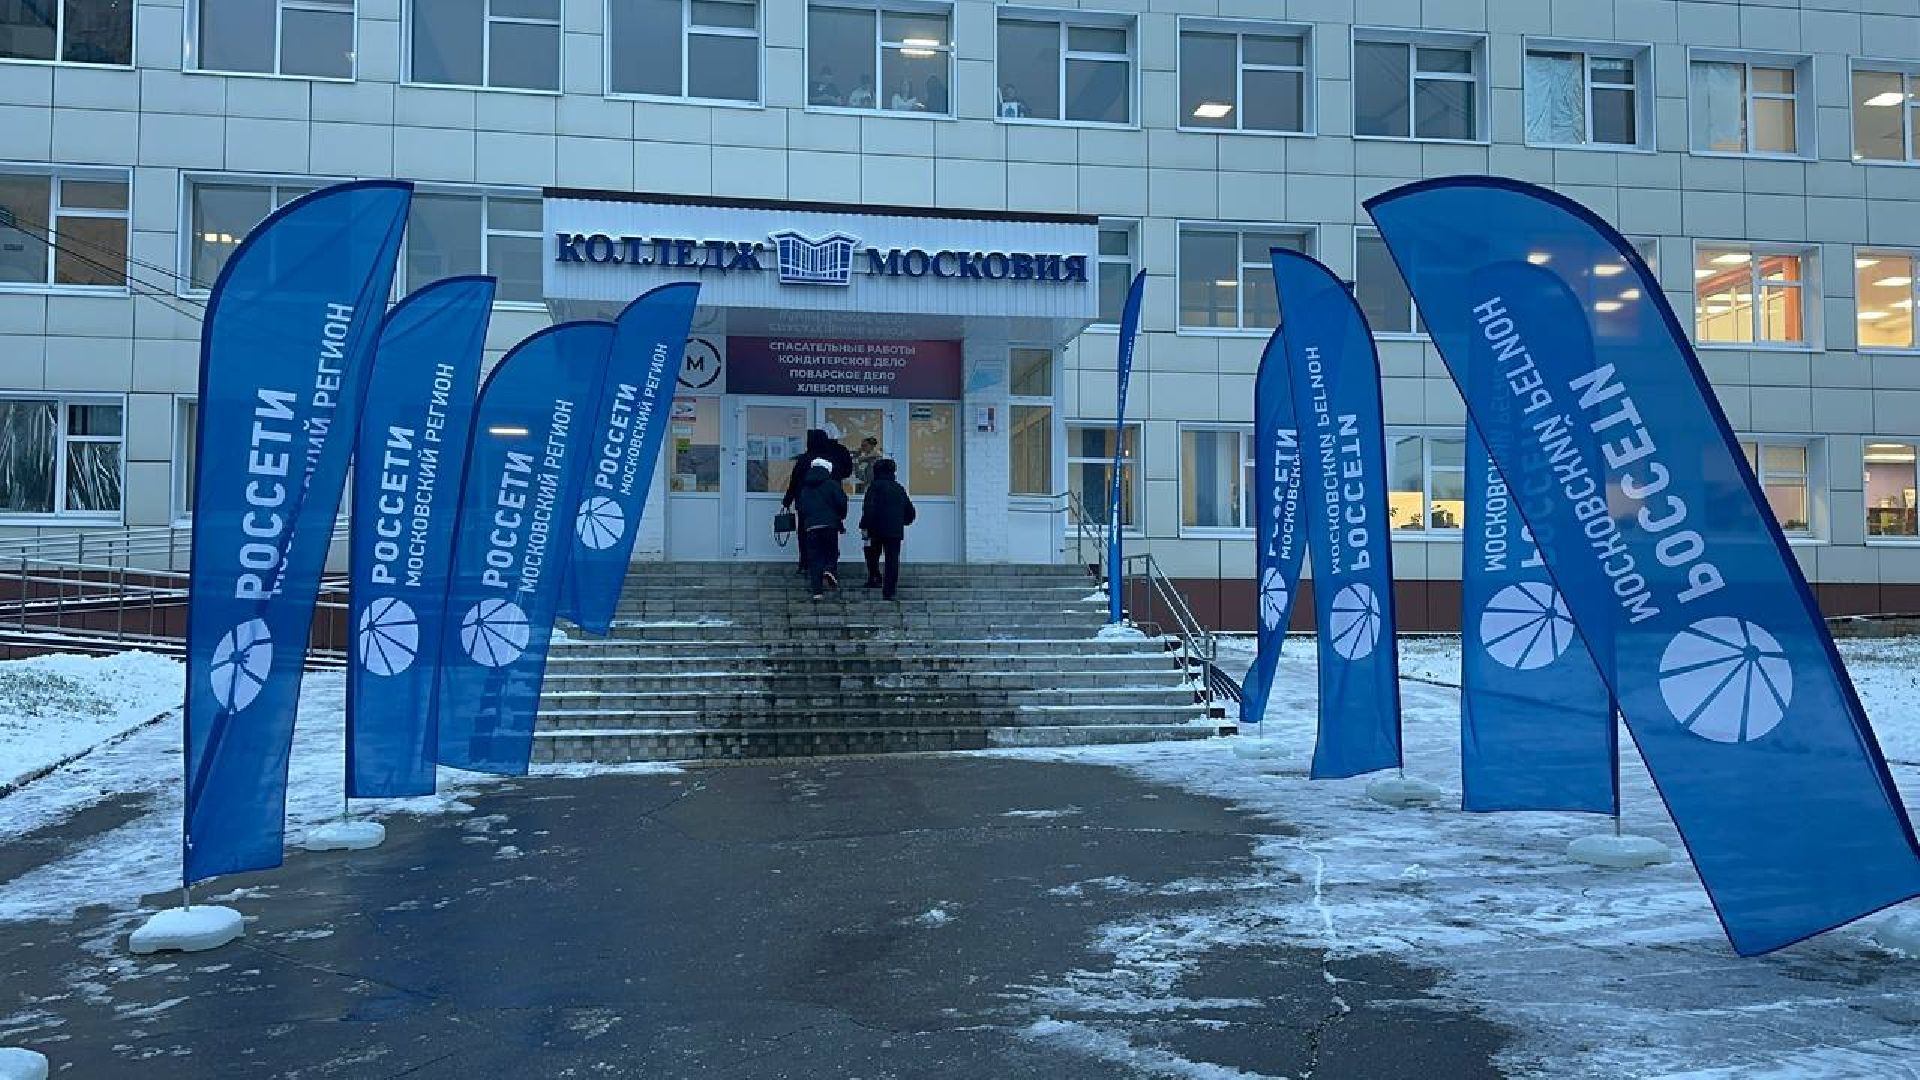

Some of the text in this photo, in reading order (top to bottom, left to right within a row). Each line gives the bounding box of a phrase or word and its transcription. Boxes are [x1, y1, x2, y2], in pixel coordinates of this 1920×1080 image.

[555, 233, 1088, 282] КОЛЛЕДЖ МОСКОВИЯ
[313, 302, 354, 409] РЕГИОН
[769, 341, 916, 355] СПАСАТЕЛЬНЫЕ РАБОТЫ
[779, 354, 907, 368] КОНДИТЕРСКОЕ ДЕЛО
[789, 369, 896, 381] ПОВАРСКОЕ ДЕЛО
[797, 383, 890, 395] ХЛЕБОПЕЧЕНИЕ
[594, 383, 638, 490] РОССЕТИ
[619, 342, 668, 495] МОСКОВСКИЙ РЕГИОН
[235, 387, 298, 600] РОССЕТИ
[371, 426, 415, 585] РОССЕТИ
[405, 363, 455, 587] МОСКОВСКИЙ РЕГИОН
[482, 450, 535, 589] РОССЕТИ
[519, 399, 574, 593] МОСКОВСКИЙ РЕГИОН
